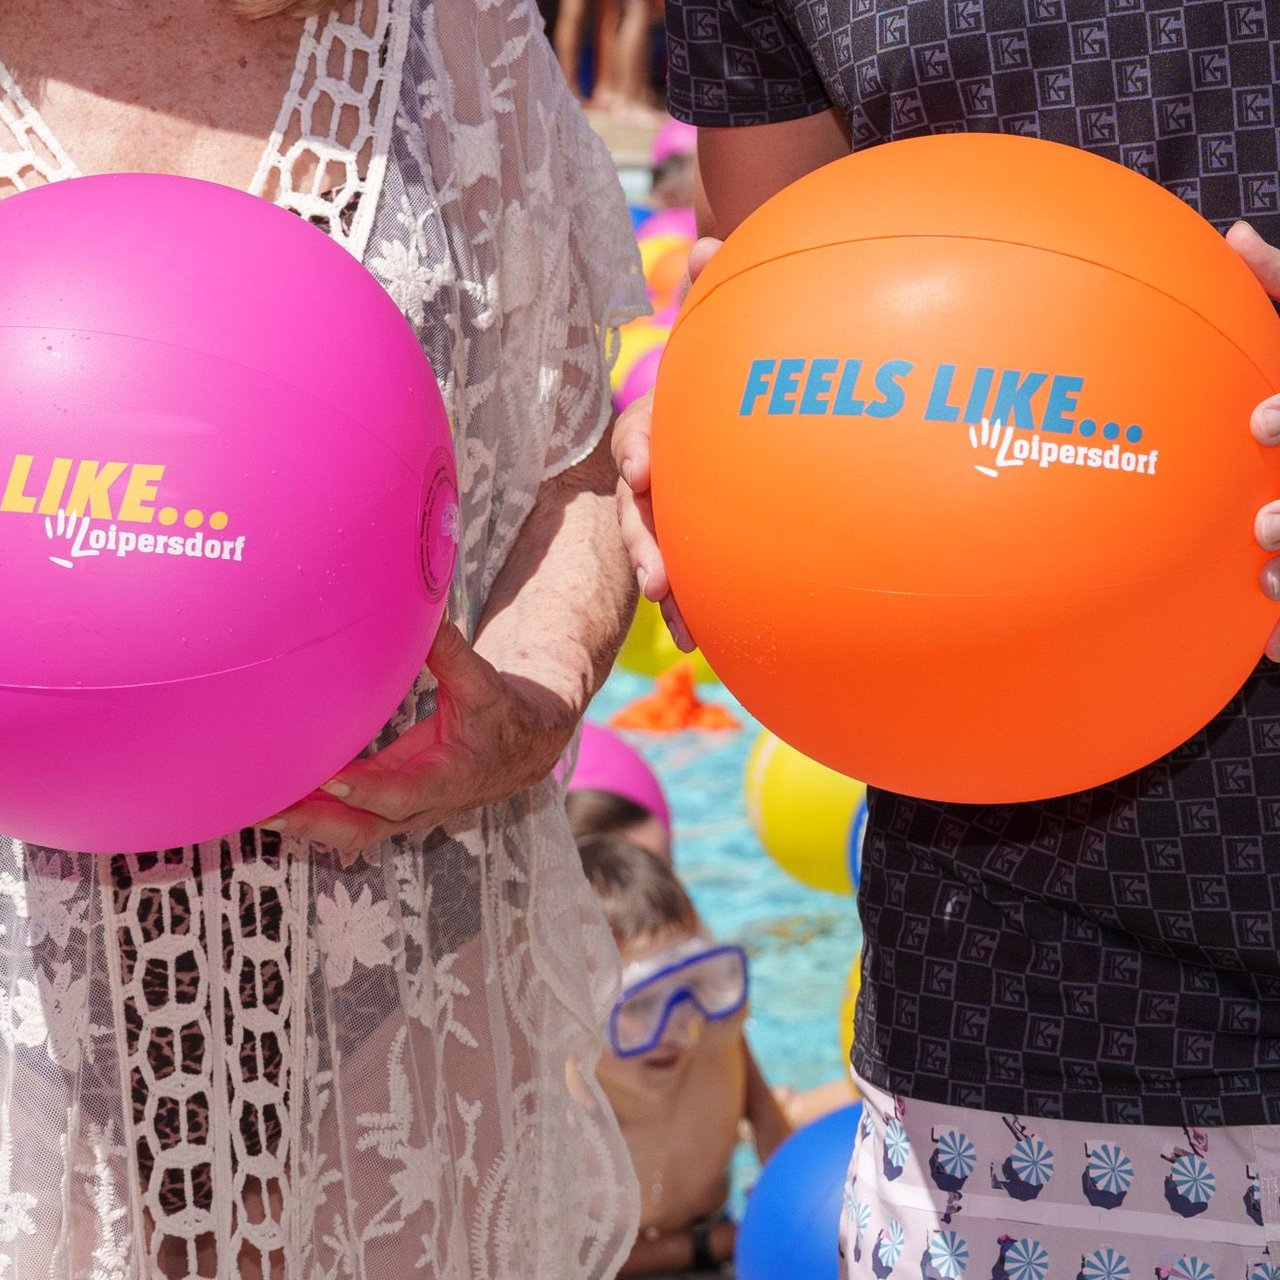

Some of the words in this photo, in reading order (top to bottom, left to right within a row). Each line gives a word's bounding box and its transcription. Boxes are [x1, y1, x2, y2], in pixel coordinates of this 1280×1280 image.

[739, 358, 915, 418] FEELS
[924, 364, 1143, 443] LIKE...
[995, 426, 1159, 475] Loipersdorf
[0, 454, 229, 530] LIKE...
[71, 516, 246, 562] Loipersdorf
